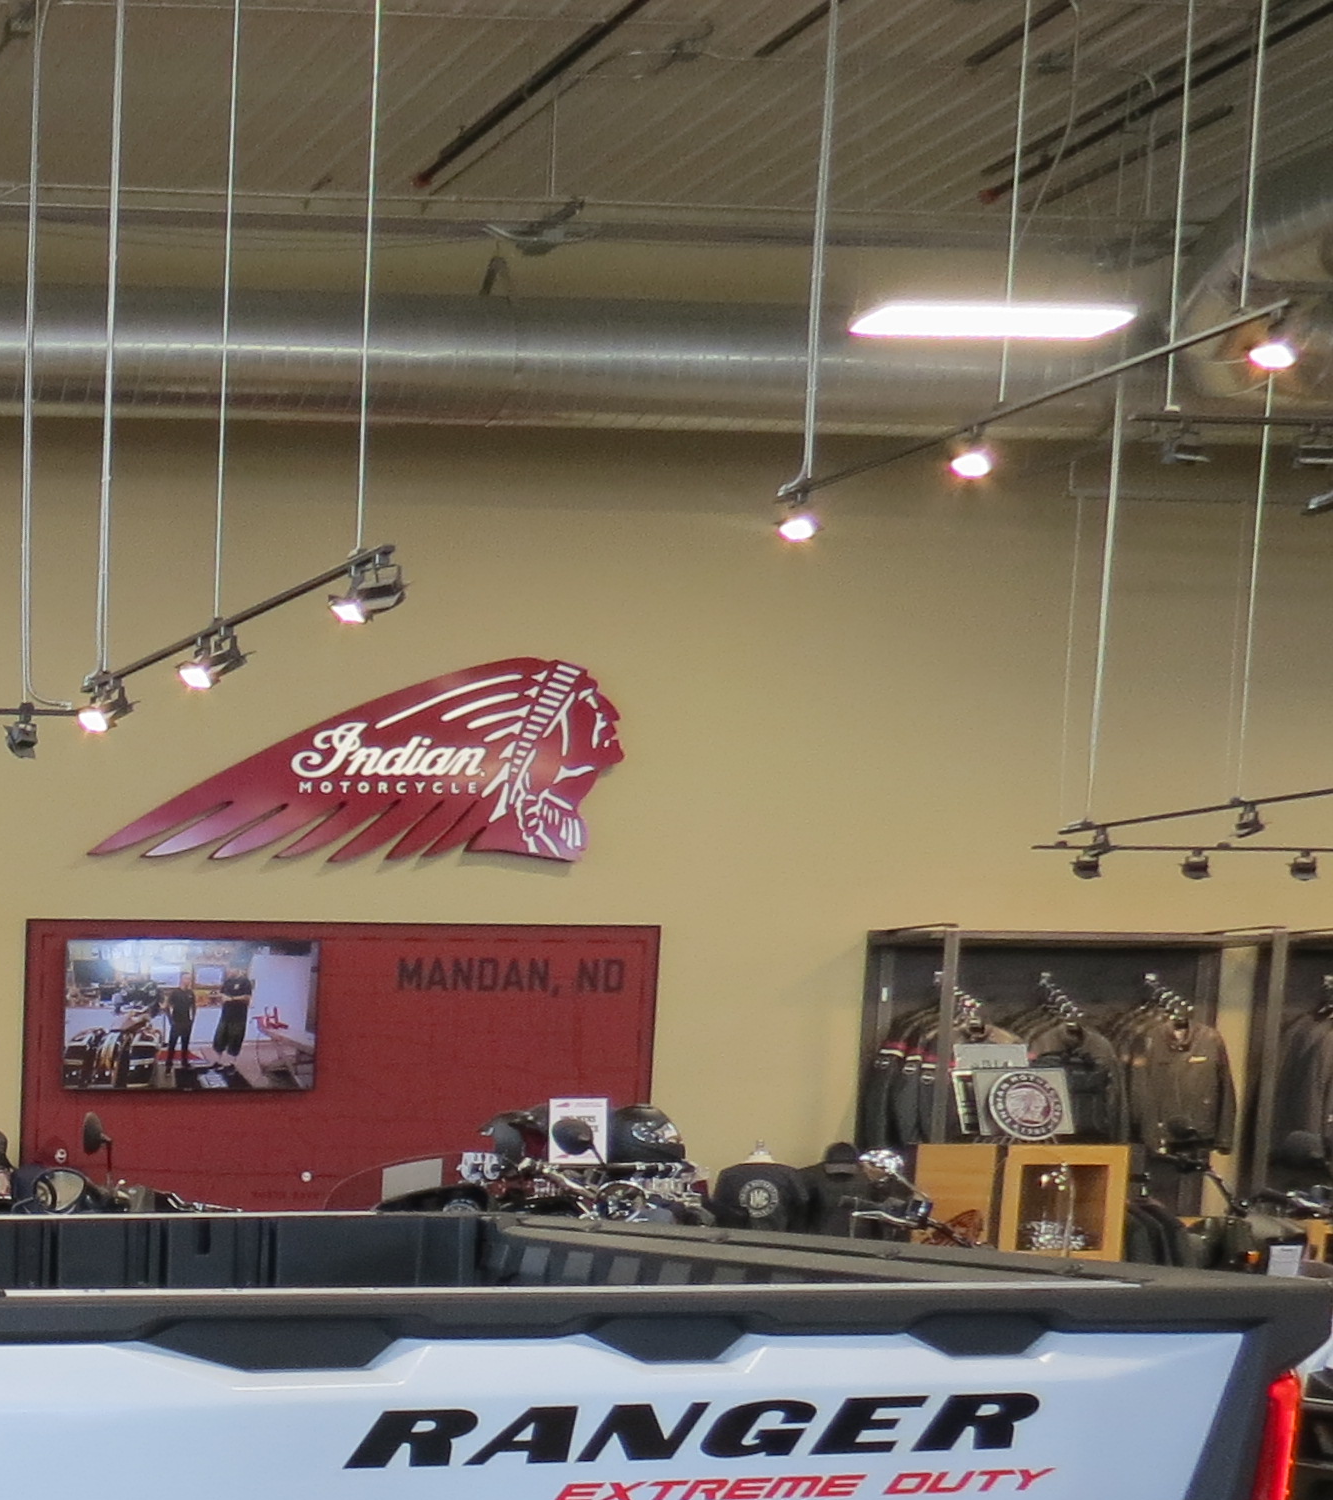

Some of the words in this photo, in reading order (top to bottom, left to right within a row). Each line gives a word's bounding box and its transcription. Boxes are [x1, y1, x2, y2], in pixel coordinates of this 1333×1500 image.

[298, 781, 478, 794] MOTORCYCLE
[397, 957, 561, 997] MANDAN,
[576, 957, 625, 993] ND
[342, 1391, 1041, 1470] RANGER
[882, 1466, 1057, 1496] DUTY
